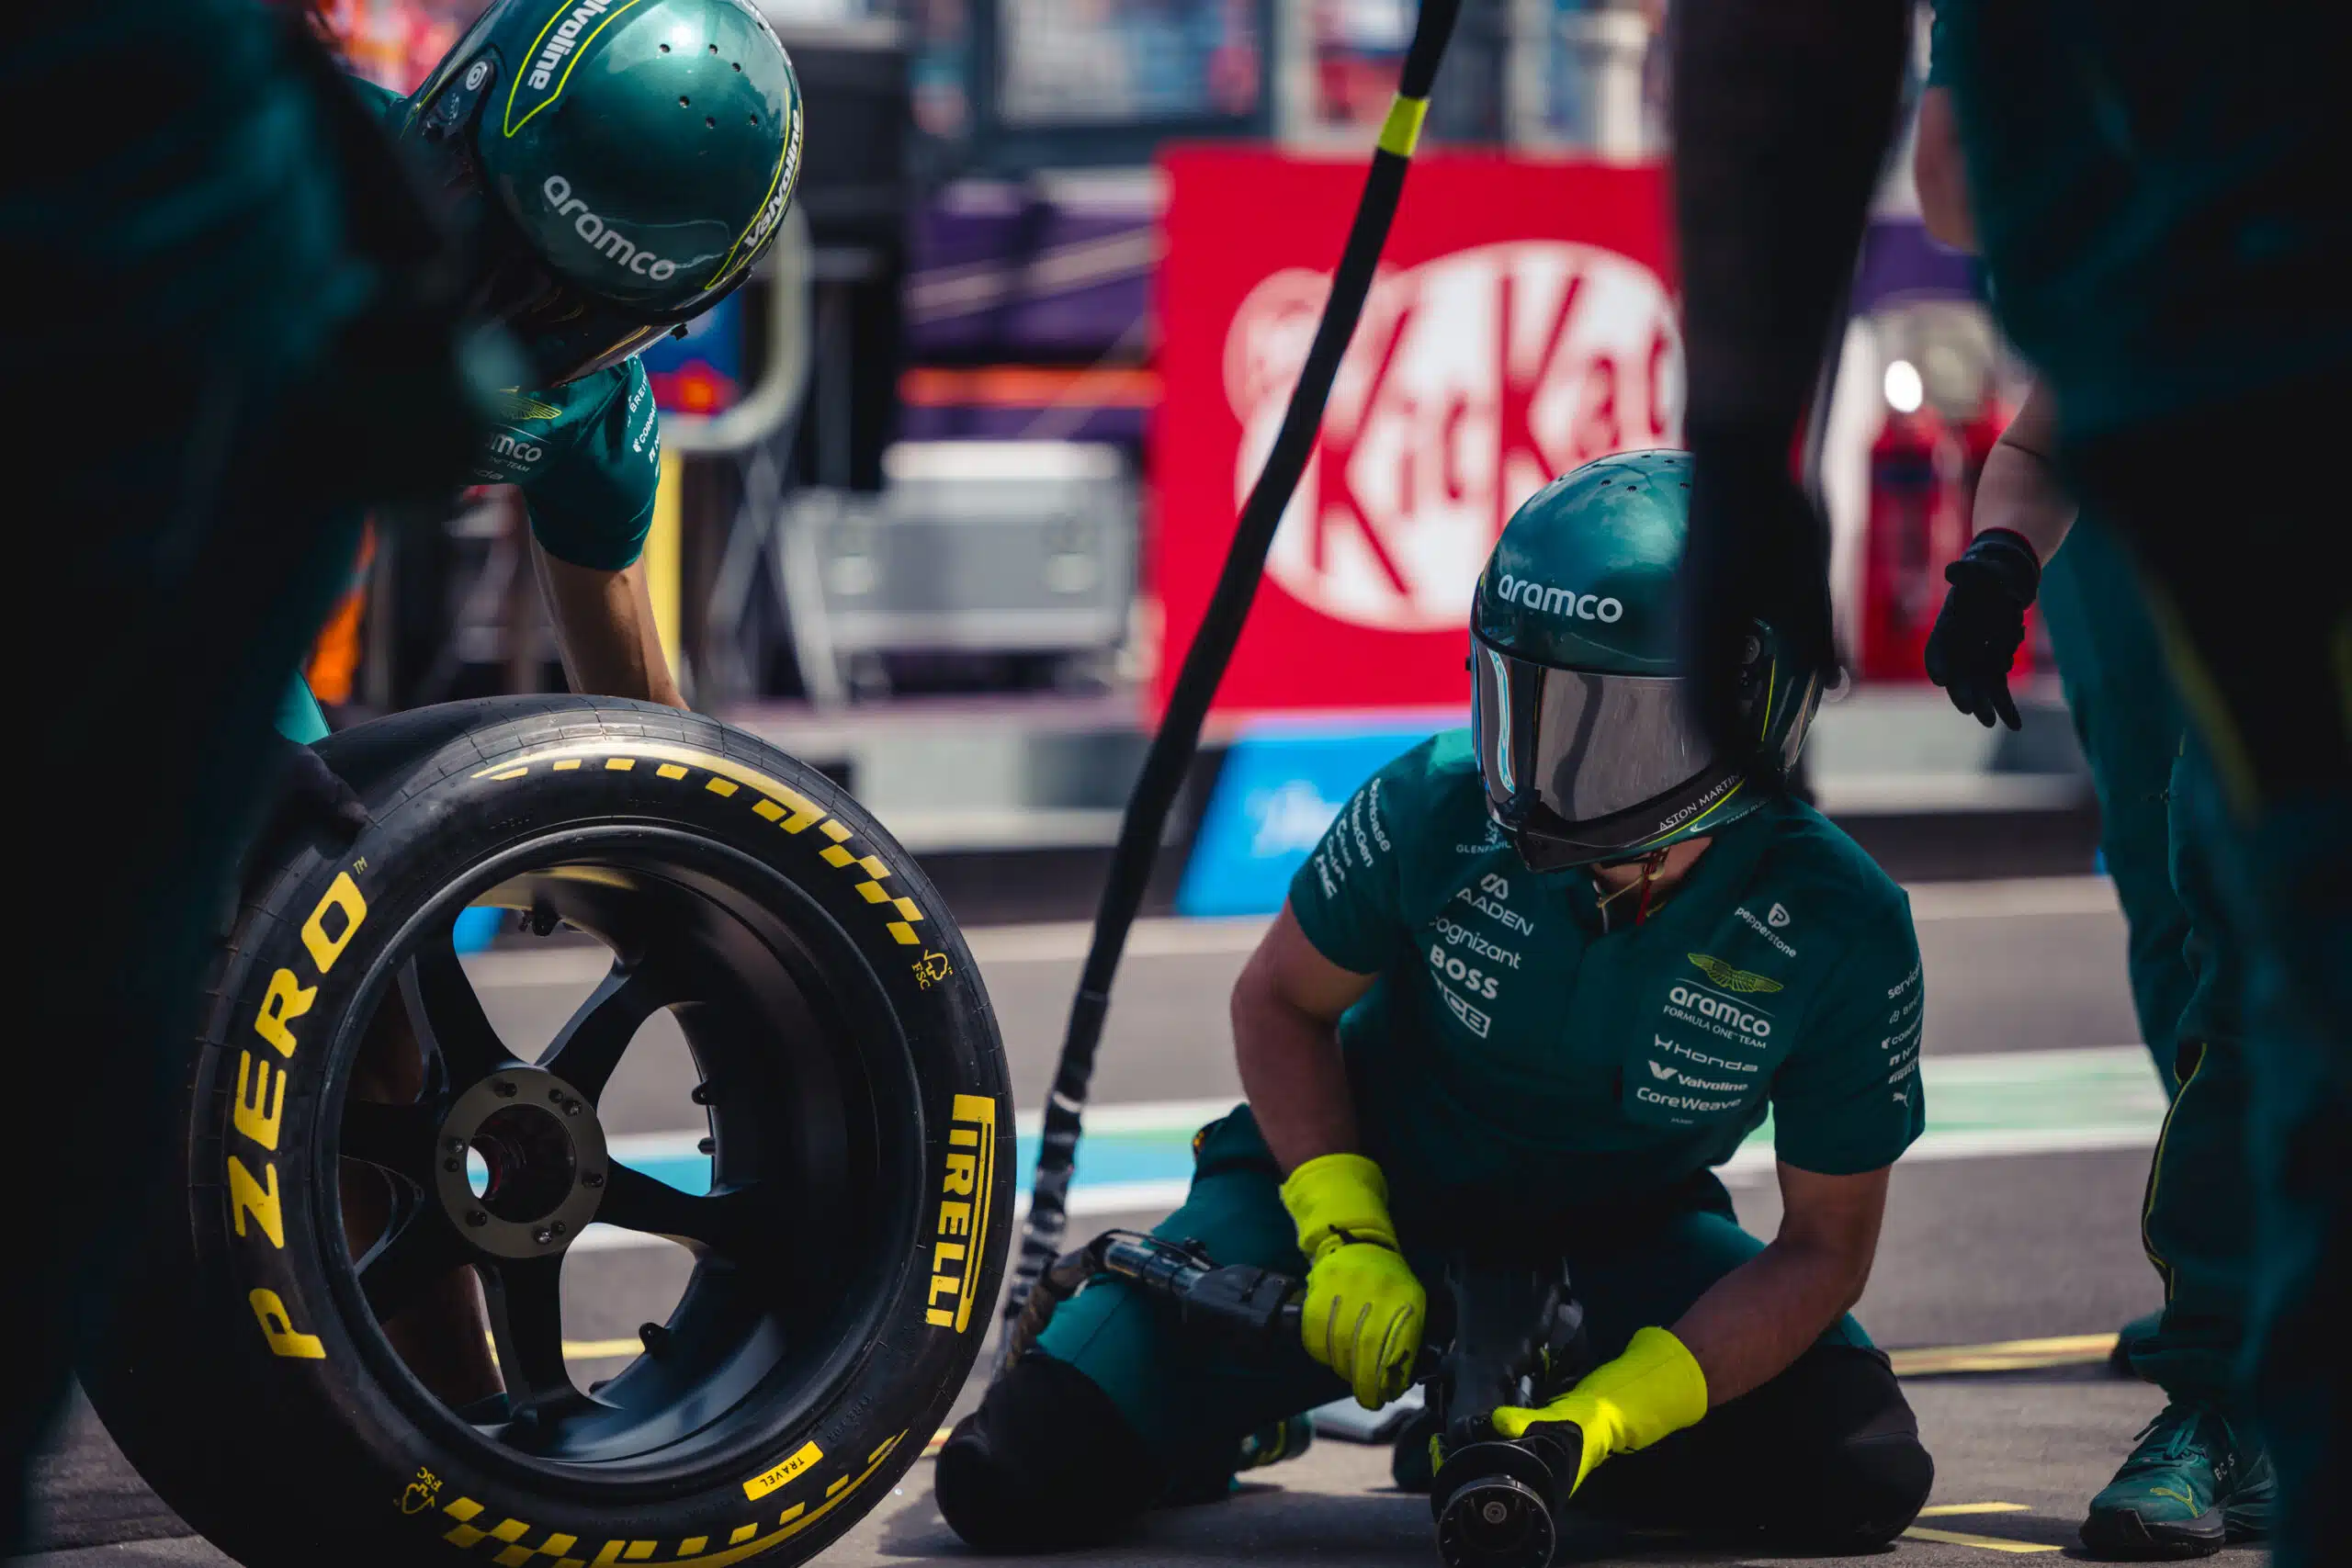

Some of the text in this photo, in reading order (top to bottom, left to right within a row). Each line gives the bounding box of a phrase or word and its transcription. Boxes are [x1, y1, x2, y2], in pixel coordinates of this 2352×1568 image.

[527, 0, 611, 90] lvoline
[744, 109, 800, 248] Valvoline
[544, 175, 675, 281] aramco
[486, 433, 543, 462] mco
[1497, 573, 1623, 624] aramco
[1658, 801, 1698, 832] ASTON
[1455, 886, 1534, 937] AADEN
[1735, 906, 1797, 958] pepperstone
[911, 961, 931, 990] FSC
[1430, 943, 1500, 1000] BOSS
[1663, 1005, 1711, 1033] FORMULA
[1739, 1033, 1767, 1049] TEAM
[1669, 987, 1771, 1037] aramco
[226, 871, 368, 1251] ZERO
[1674, 1043, 1758, 1073] Honda
[1678, 1074, 1748, 1092] Valvoline
[1636, 1087, 1742, 1111] CoreWeave
[926, 1093, 996, 1335] PIRELLI
[249, 1288, 326, 1359] P
[416, 1465, 445, 1493] FSC
[760, 1457, 805, 1487] TRAVEL
